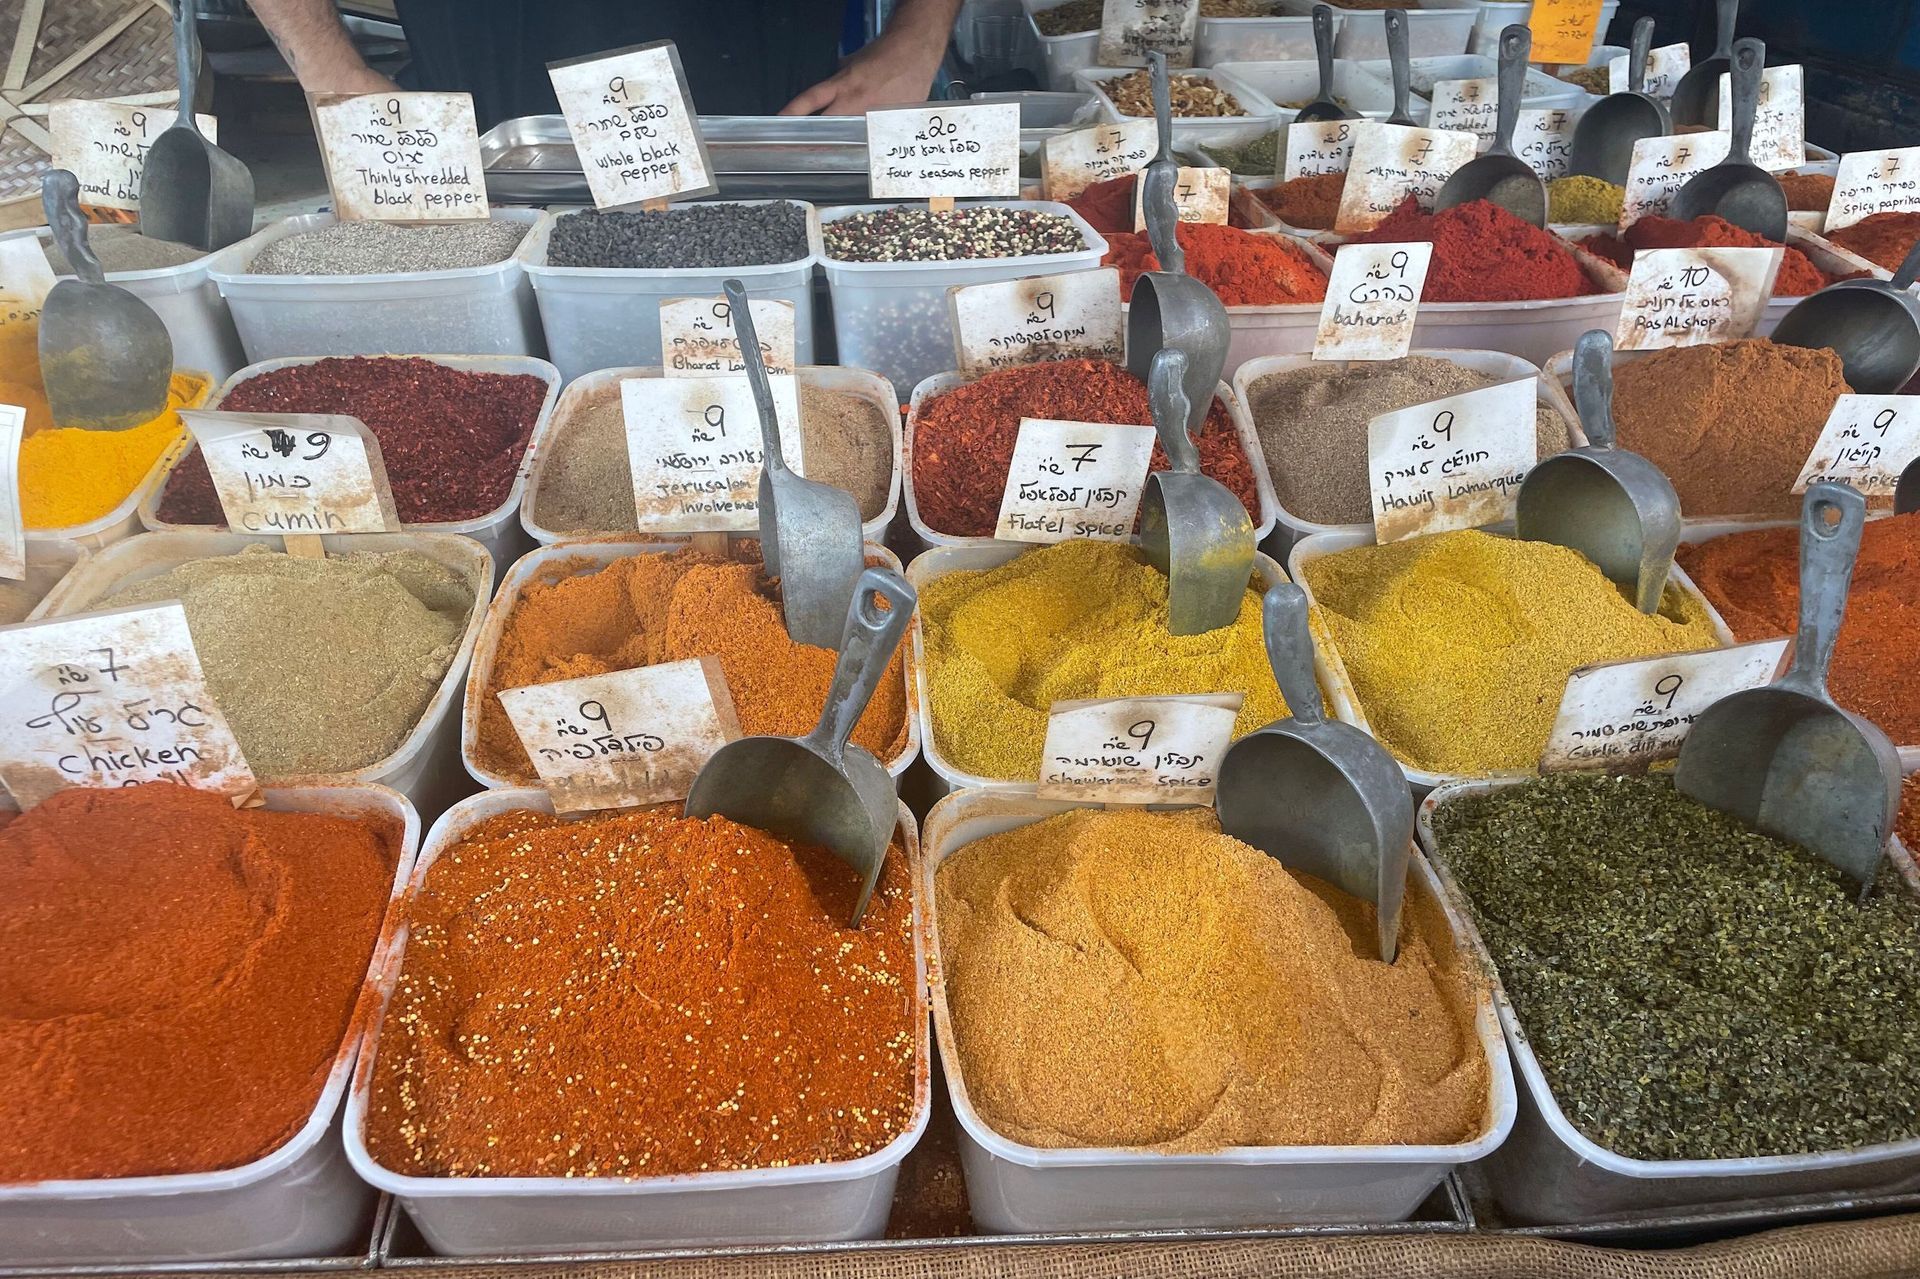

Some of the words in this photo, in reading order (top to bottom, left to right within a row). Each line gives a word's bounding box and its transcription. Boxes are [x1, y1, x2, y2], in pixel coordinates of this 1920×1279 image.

[609, 76, 628, 100] 9
[1469, 86, 1479, 102] 7
[387, 99, 402, 124] 9
[1552, 112, 1567, 131] 7
[132, 112, 147, 137] 9
[928, 116, 957, 138] 20
[1338, 124, 1350, 141] 8
[351, 133, 392, 147] שחור
[397, 129, 438, 148] פלפל
[1110, 131, 1127, 150] 7
[1417, 138, 1434, 158] 7
[639, 142, 681, 162] black
[1677, 148, 1692, 164] 7
[356, 168, 401, 187] Thinly
[405, 166, 471, 185] shredded
[620, 162, 678, 185] pepper
[919, 169, 965, 180] seasons
[1887, 158, 1900, 176] 7
[374, 189, 412, 205] black
[424, 194, 482, 209] pepper
[1177, 184, 1198, 203] 7
[1391, 251, 1408, 278] 9
[1679, 266, 1710, 288] 10
[712, 303, 731, 327] 9
[1036, 292, 1055, 318] 9
[705, 405, 726, 437] 9
[1433, 410, 1455, 442] 9
[1873, 409, 1897, 438] 9
[302, 432, 332, 460] 9
[1066, 444, 1103, 472] 7
[1084, 488, 1128, 509] תבלין
[88, 647, 130, 682] 7
[1655, 674, 1683, 709] 9
[579, 700, 612, 731] 9
[1127, 719, 1156, 750] 9
